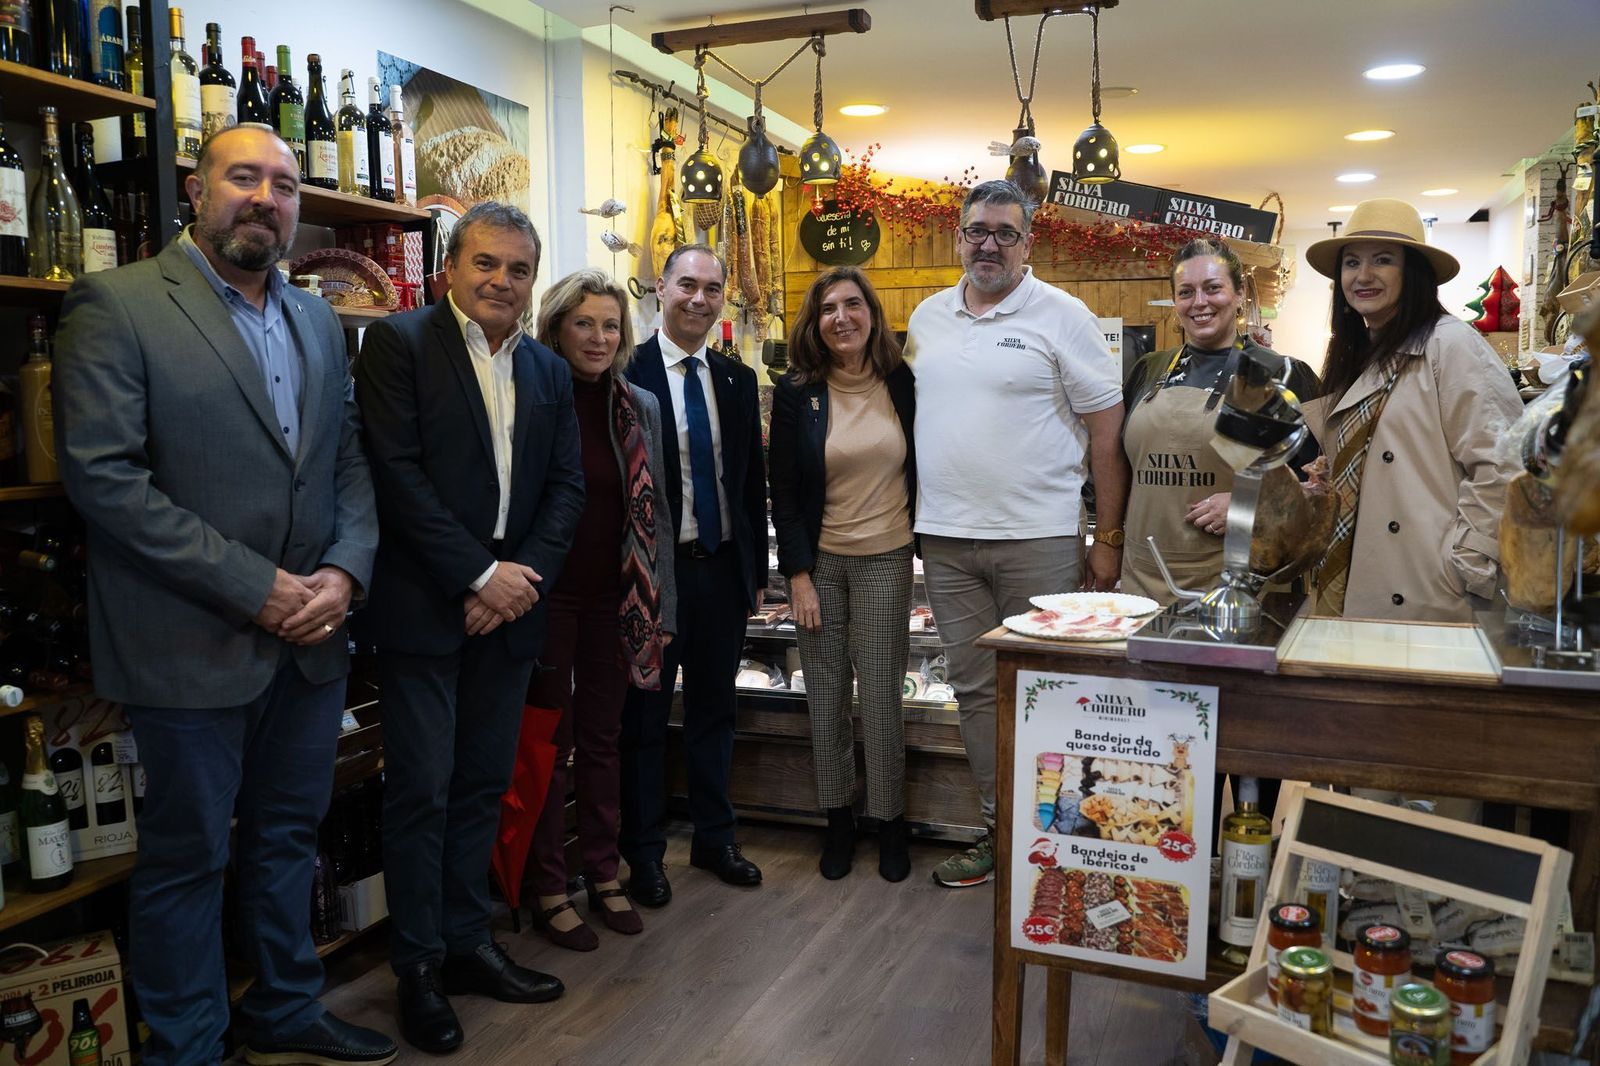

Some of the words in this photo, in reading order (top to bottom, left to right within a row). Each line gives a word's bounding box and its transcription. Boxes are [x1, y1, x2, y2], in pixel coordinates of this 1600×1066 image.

[1057, 176, 1103, 198] SILVA
[1053, 191, 1131, 218] CORDERO
[1167, 197, 1217, 219] SILVA
[827, 225, 837, 236] de
[1164, 211, 1245, 239] CORDERO
[822, 240, 835, 251] sin
[996, 342, 1026, 350] CORDERO
[1147, 453, 1198, 470] SILVA
[1137, 470, 1216, 487] CORDERO
[1095, 693, 1134, 706] SILVA
[1083, 703, 1146, 717] CORDERO
[1074, 729, 1131, 746] Bandeja
[1135, 735, 1153, 746] de
[1066, 741, 1107, 752] queso
[1111, 742, 1161, 758] surtido
[94, 831, 133, 845] RIOJA
[1161, 838, 1192, 854] 25€
[1071, 844, 1127, 862] Bandeja
[1131, 852, 1149, 863] de
[1082, 855, 1136, 872] ibéricos
[1026, 923, 1056, 936] 25€
[38, 984, 50, 997] 2
[52, 970, 116, 994] PELIRROJA
